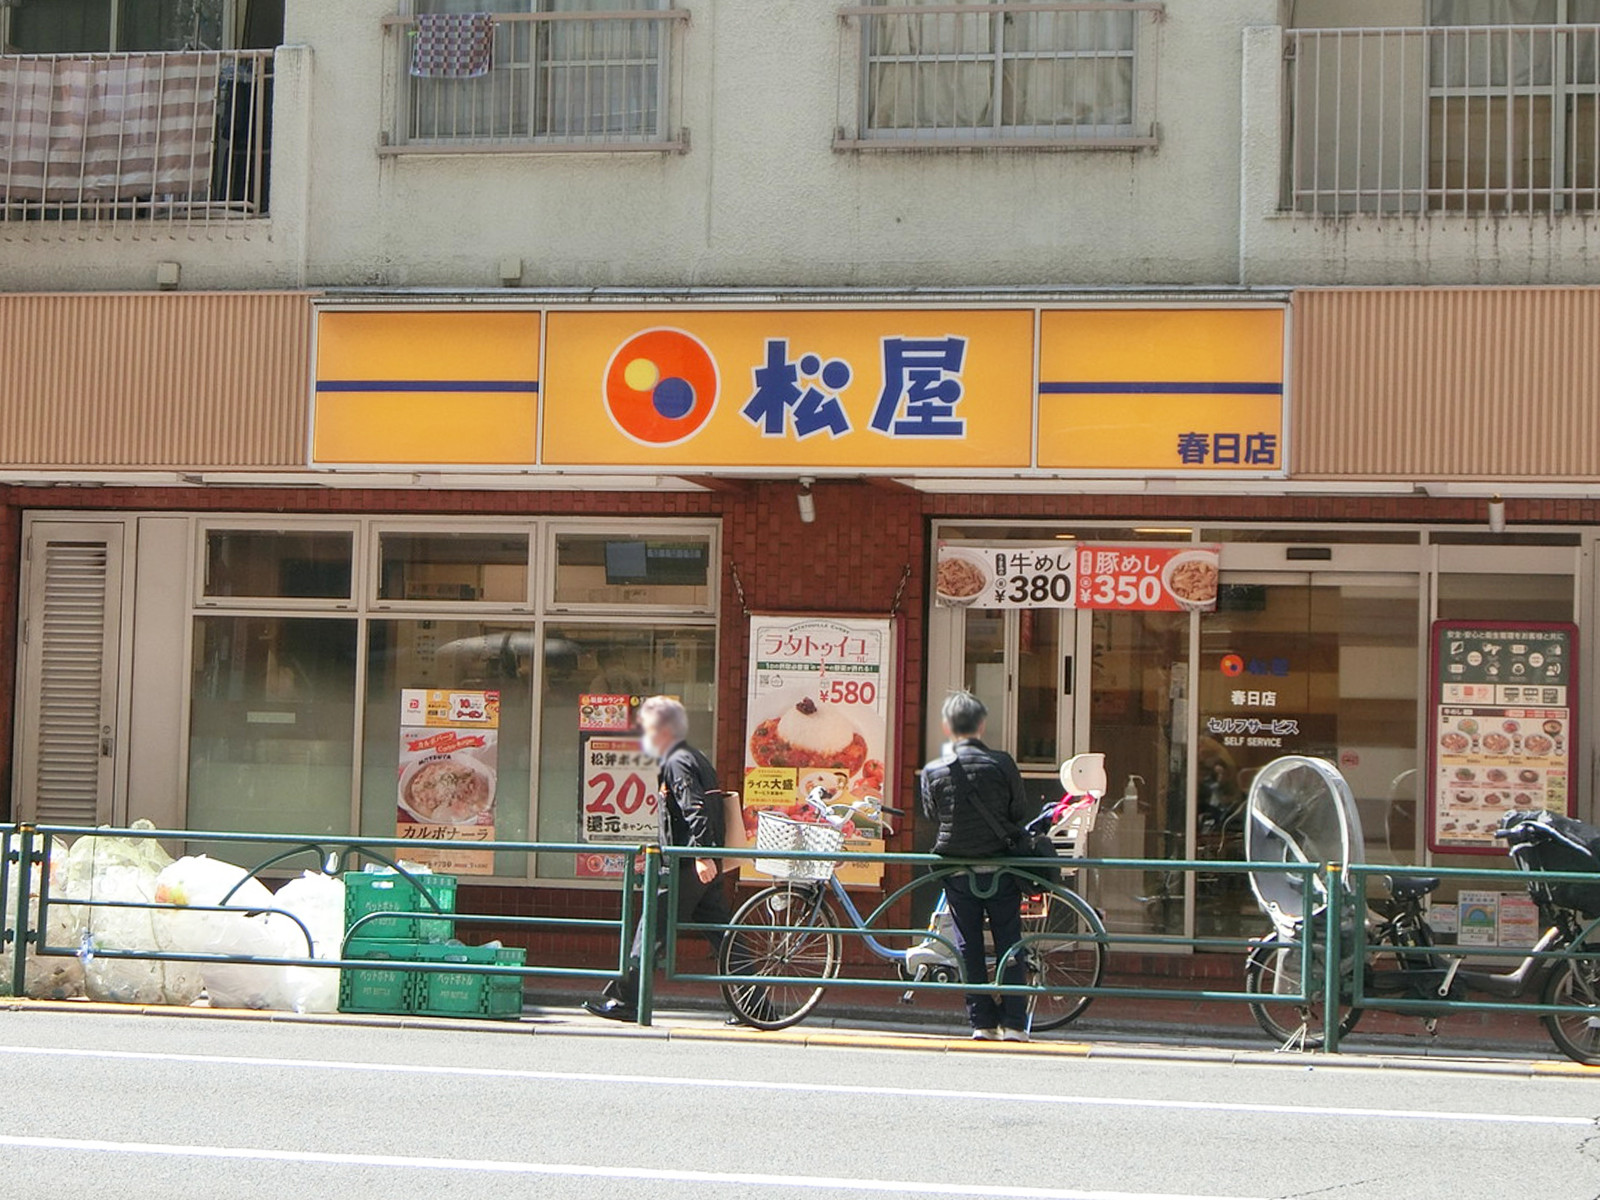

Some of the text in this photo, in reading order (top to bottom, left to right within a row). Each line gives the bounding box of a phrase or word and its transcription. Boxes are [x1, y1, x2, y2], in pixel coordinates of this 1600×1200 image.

[741, 335, 967, 440] 松屋
[1177, 432, 1277, 464] 春日店
[1010, 553, 1072, 575] 牛めし
[1096, 552, 1160, 574] 豚めし
[995, 574, 1072, 604] ¥380
[1079, 575, 1161, 605] ¥350
[765, 634, 869, 658] ラタトゥイユ
[820, 681, 876, 704] ¥580
[1231, 690, 1277, 706] 春日店
[1207, 718, 1300, 735] セルフサービス
[1224, 737, 1282, 748] SELF SERVICE
[747, 778, 794, 791] ライス大盛
[402, 825, 489, 841] カルボナーラ
[587, 815, 659, 833] 還元キャンペー
